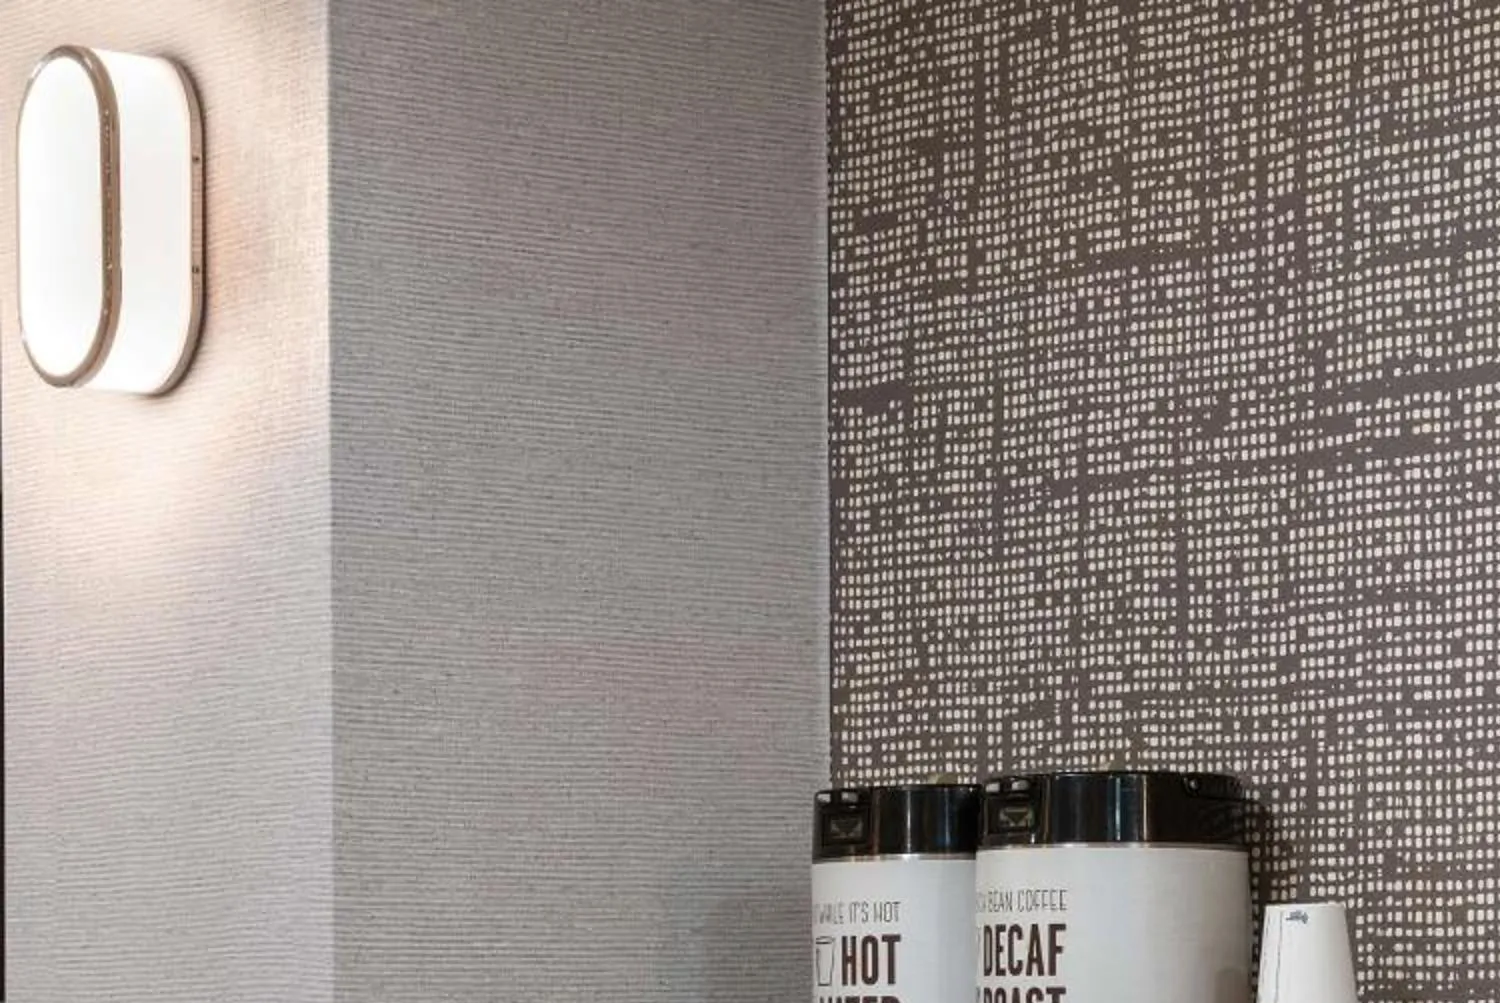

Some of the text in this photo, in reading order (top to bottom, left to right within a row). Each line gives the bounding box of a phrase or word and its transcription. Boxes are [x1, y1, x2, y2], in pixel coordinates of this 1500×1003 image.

[848, 900, 869, 924] IT'S
[873, 900, 901, 923] HOT
[987, 889, 1013, 912] BEAN
[1017, 888, 1068, 912] COFFEE
[841, 934, 901, 986] HOT
[983, 923, 1067, 977] DECAF
